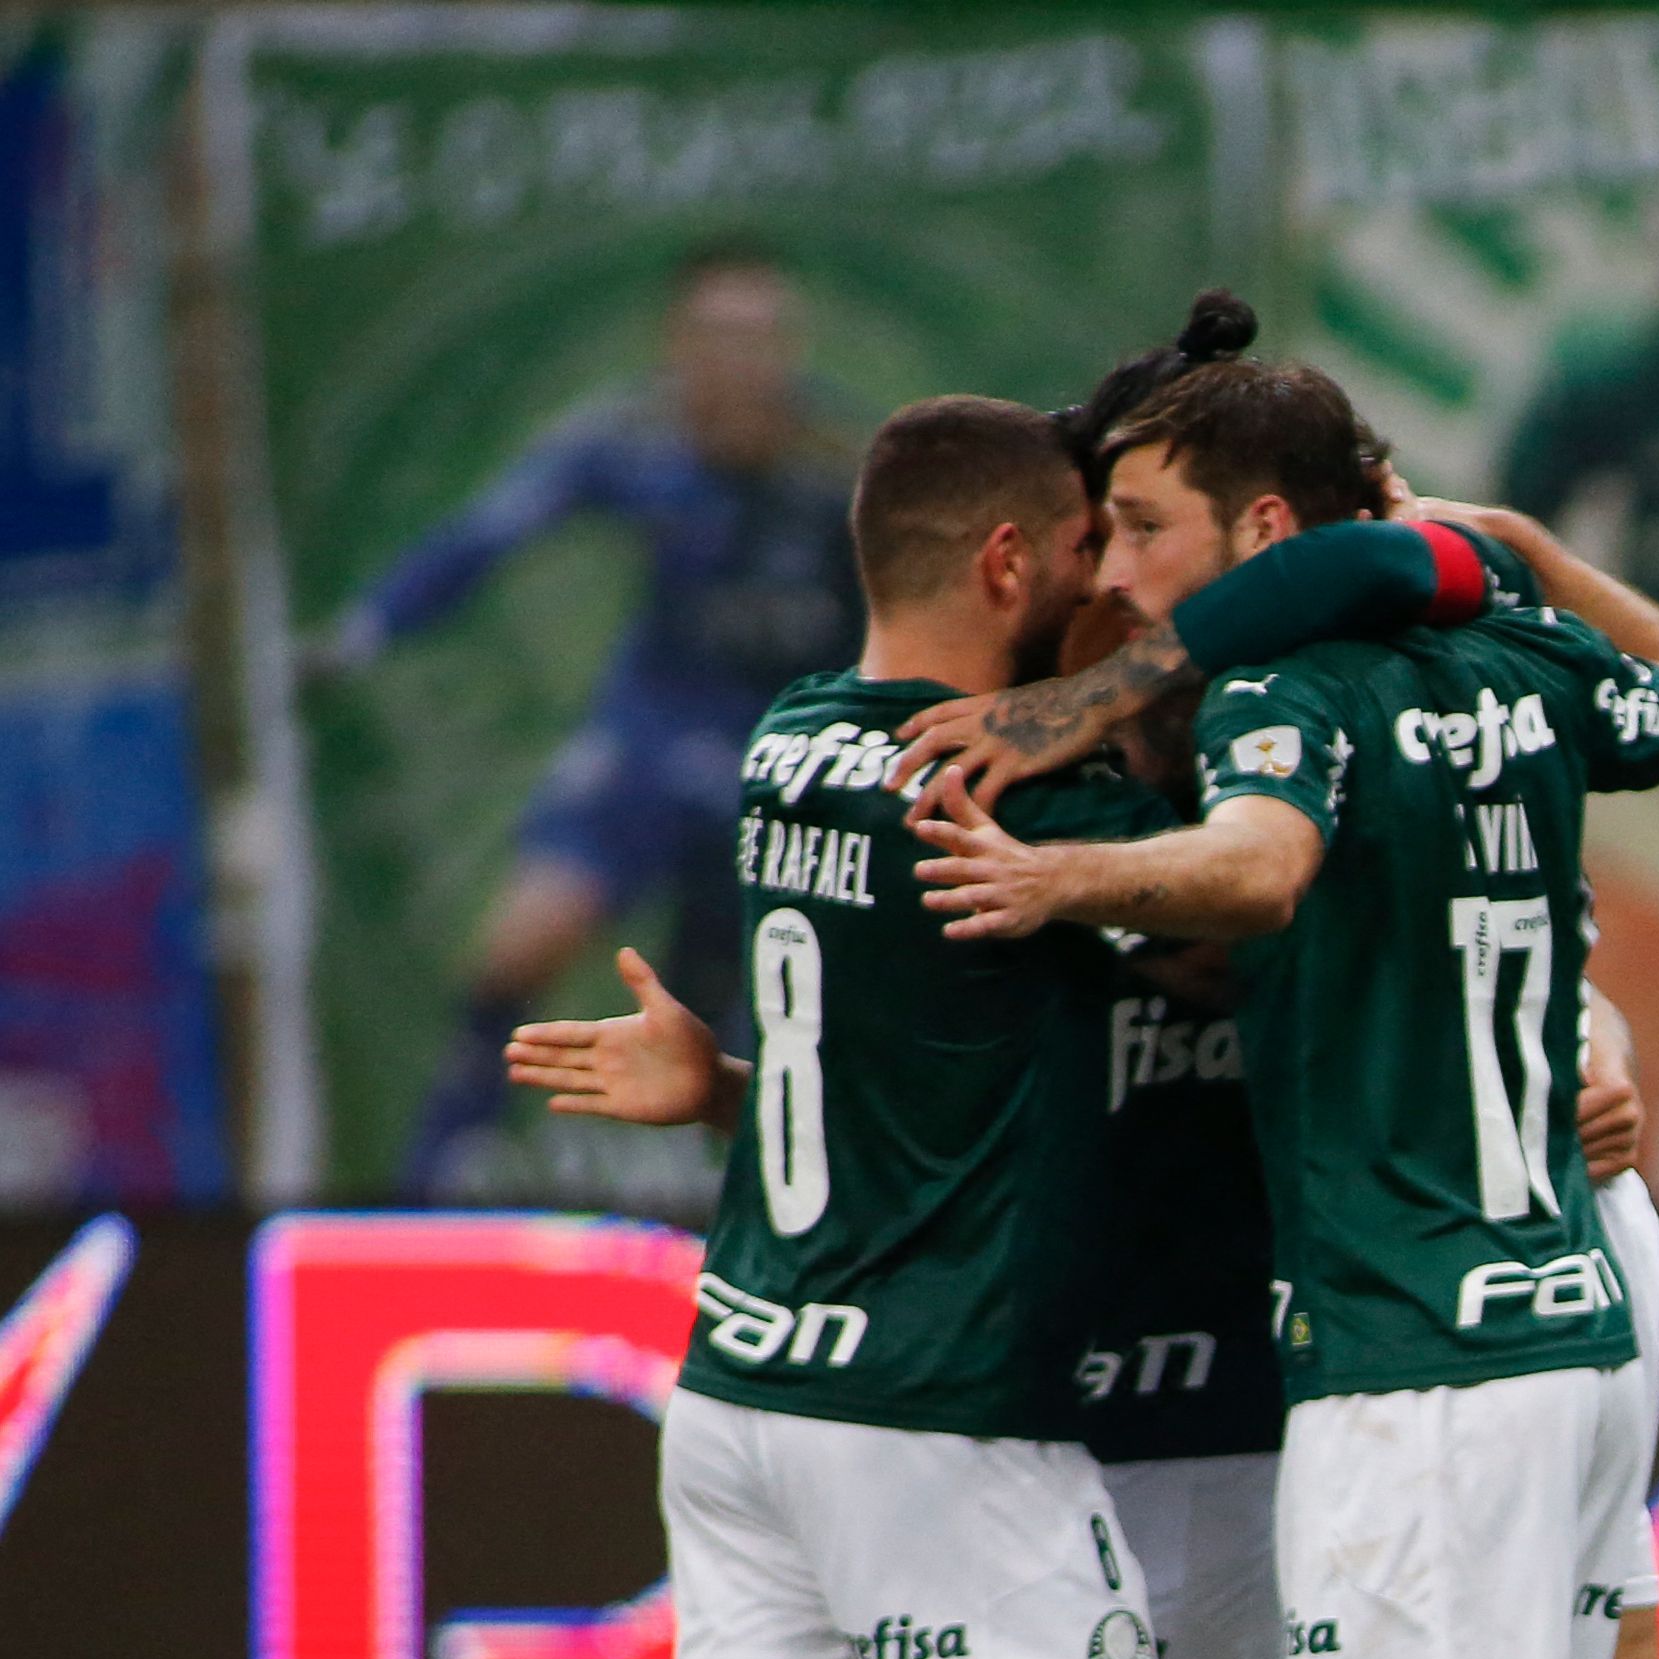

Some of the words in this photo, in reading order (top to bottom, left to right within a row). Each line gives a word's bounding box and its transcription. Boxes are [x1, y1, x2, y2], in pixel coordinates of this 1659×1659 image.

[761, 818, 875, 905] RAFAEL
[752, 906, 830, 1238] 8
[1450, 895, 1561, 1221] 17
